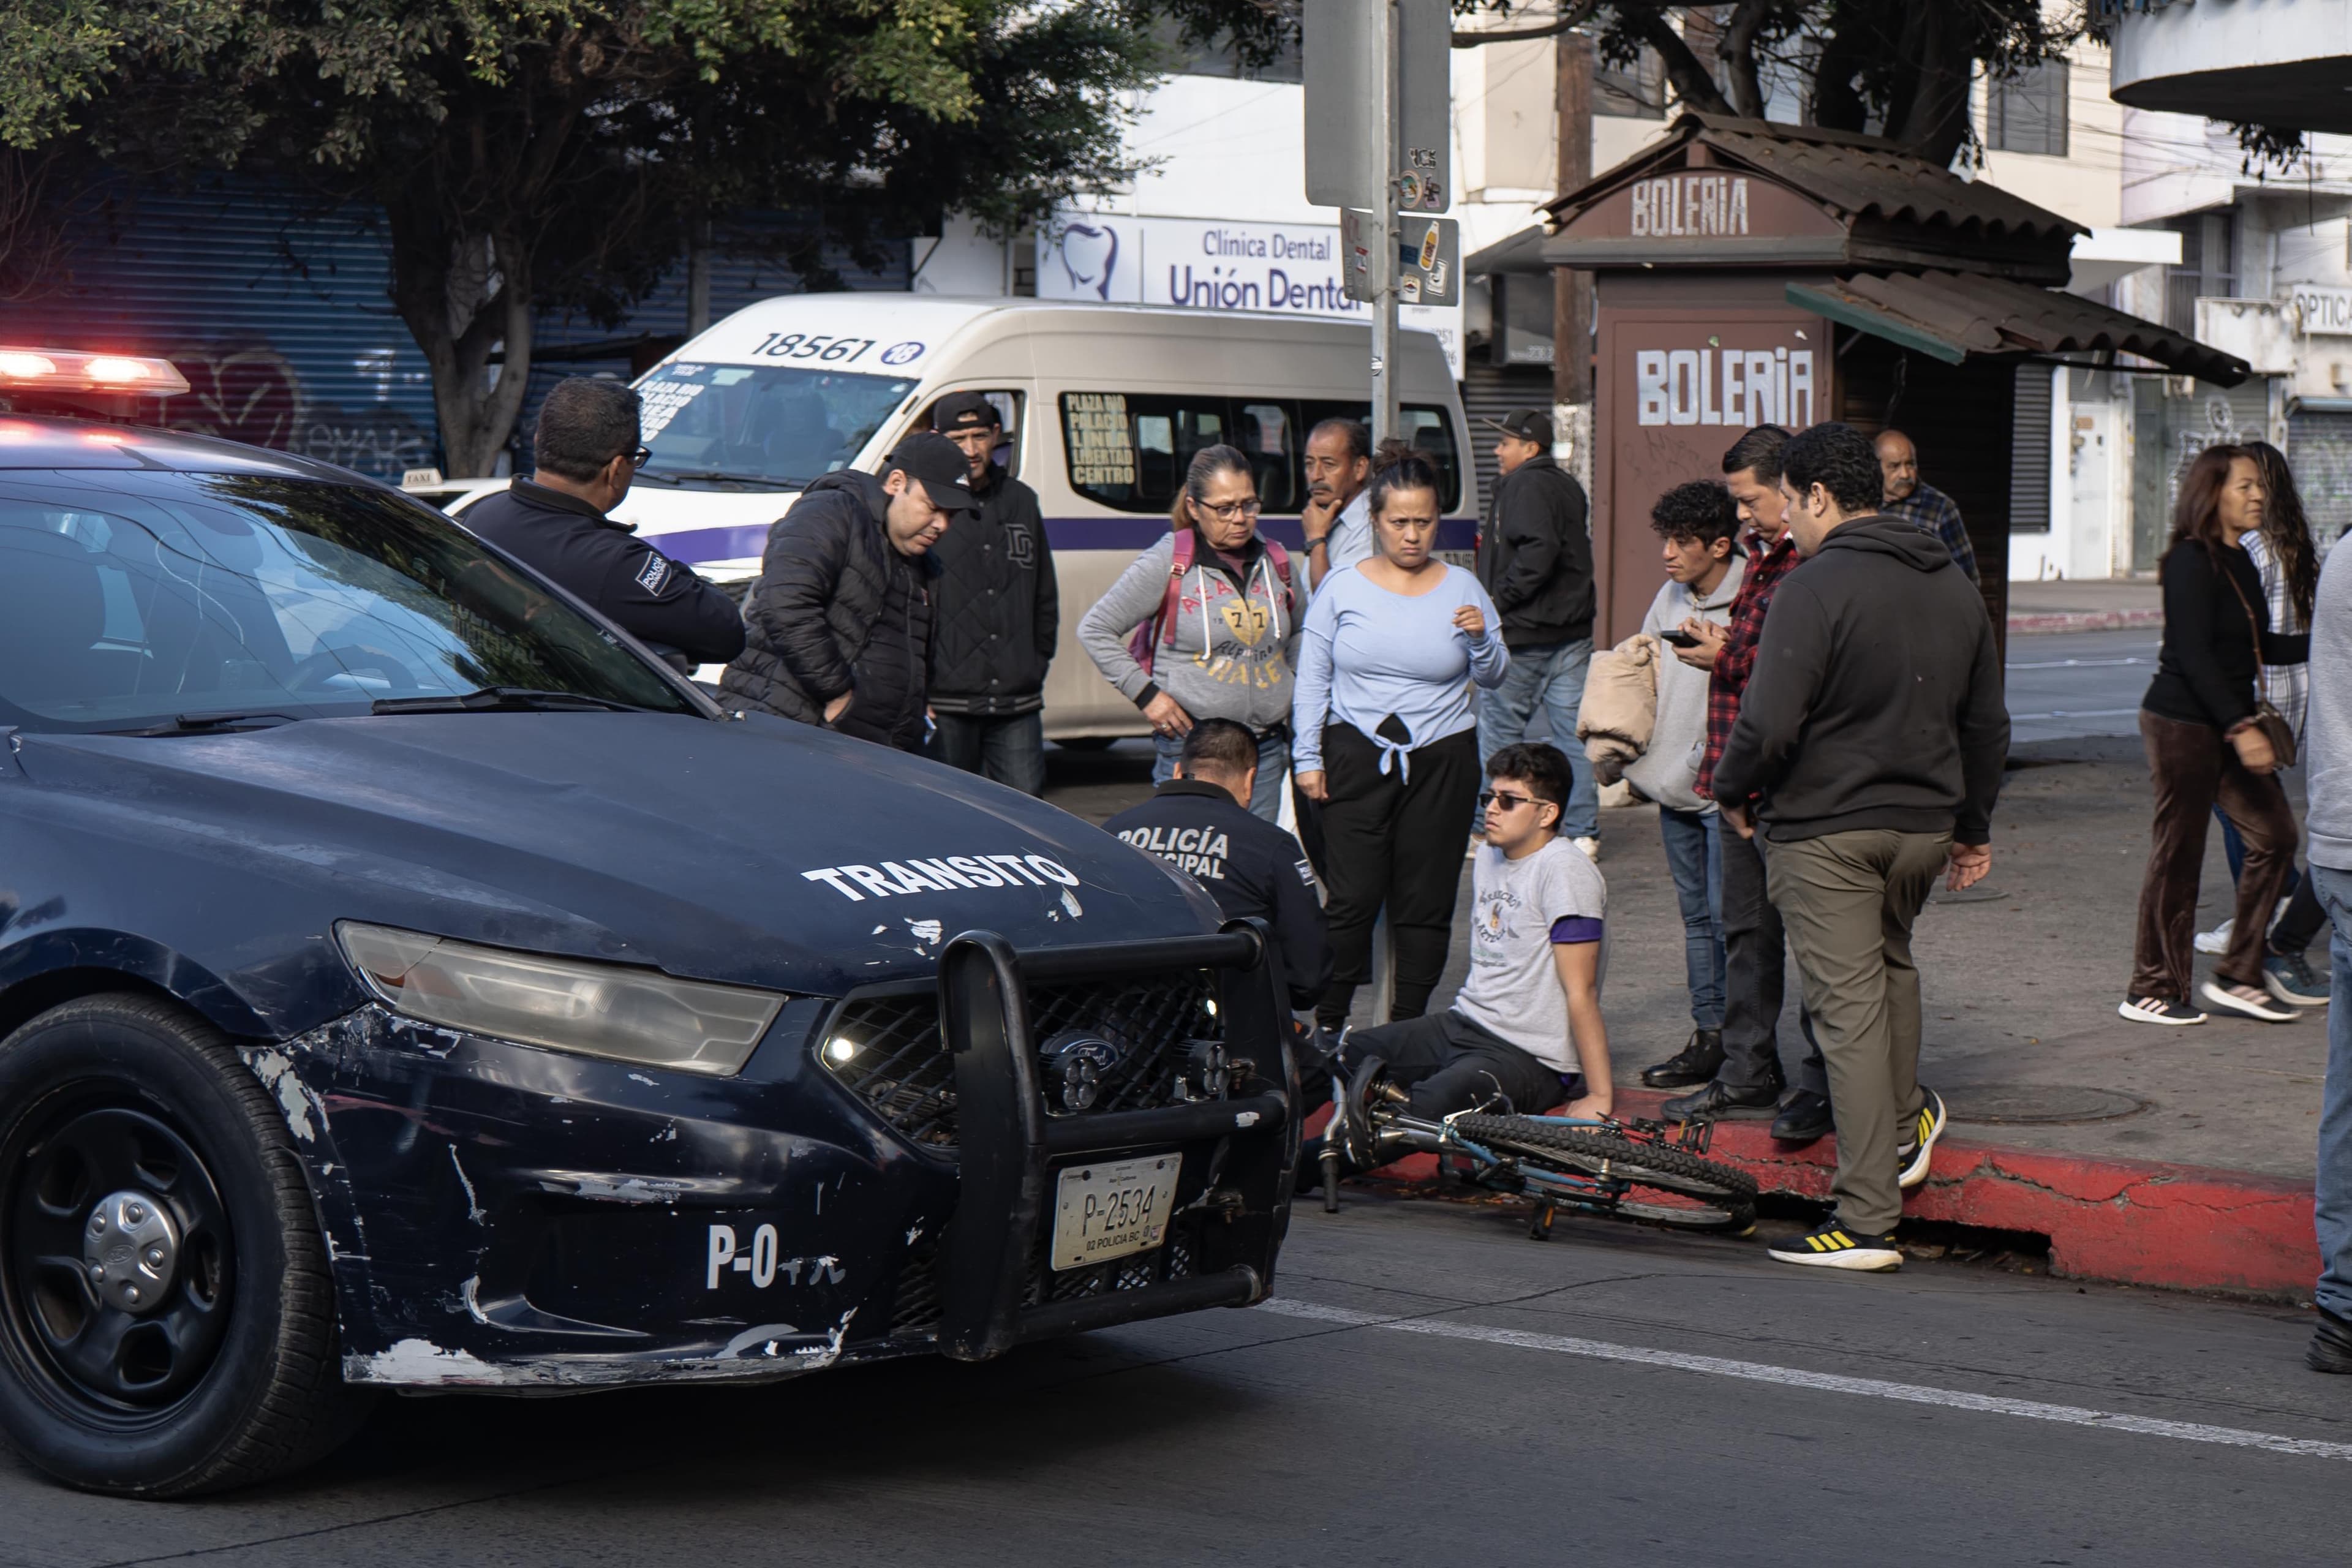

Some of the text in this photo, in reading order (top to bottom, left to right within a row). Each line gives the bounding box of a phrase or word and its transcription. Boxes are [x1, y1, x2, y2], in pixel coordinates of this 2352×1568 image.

[1204, 230, 1330, 260] Clínica Dental
[1170, 264, 1259, 307] Unión
[2296, 293, 2352, 326] OPTIC
[752, 333, 876, 363] 18561
[1069, 412, 1128, 429] PALACIO
[1073, 448, 1133, 466] LIBERTAD
[407, 473, 431, 483] TAXI
[1073, 466, 1134, 484] CENTRO
[801, 855, 1080, 901] TRANSITO
[1082, 1184, 1156, 1237] P-2534
[1086, 1230, 1140, 1251] 02 POLICIA BC
